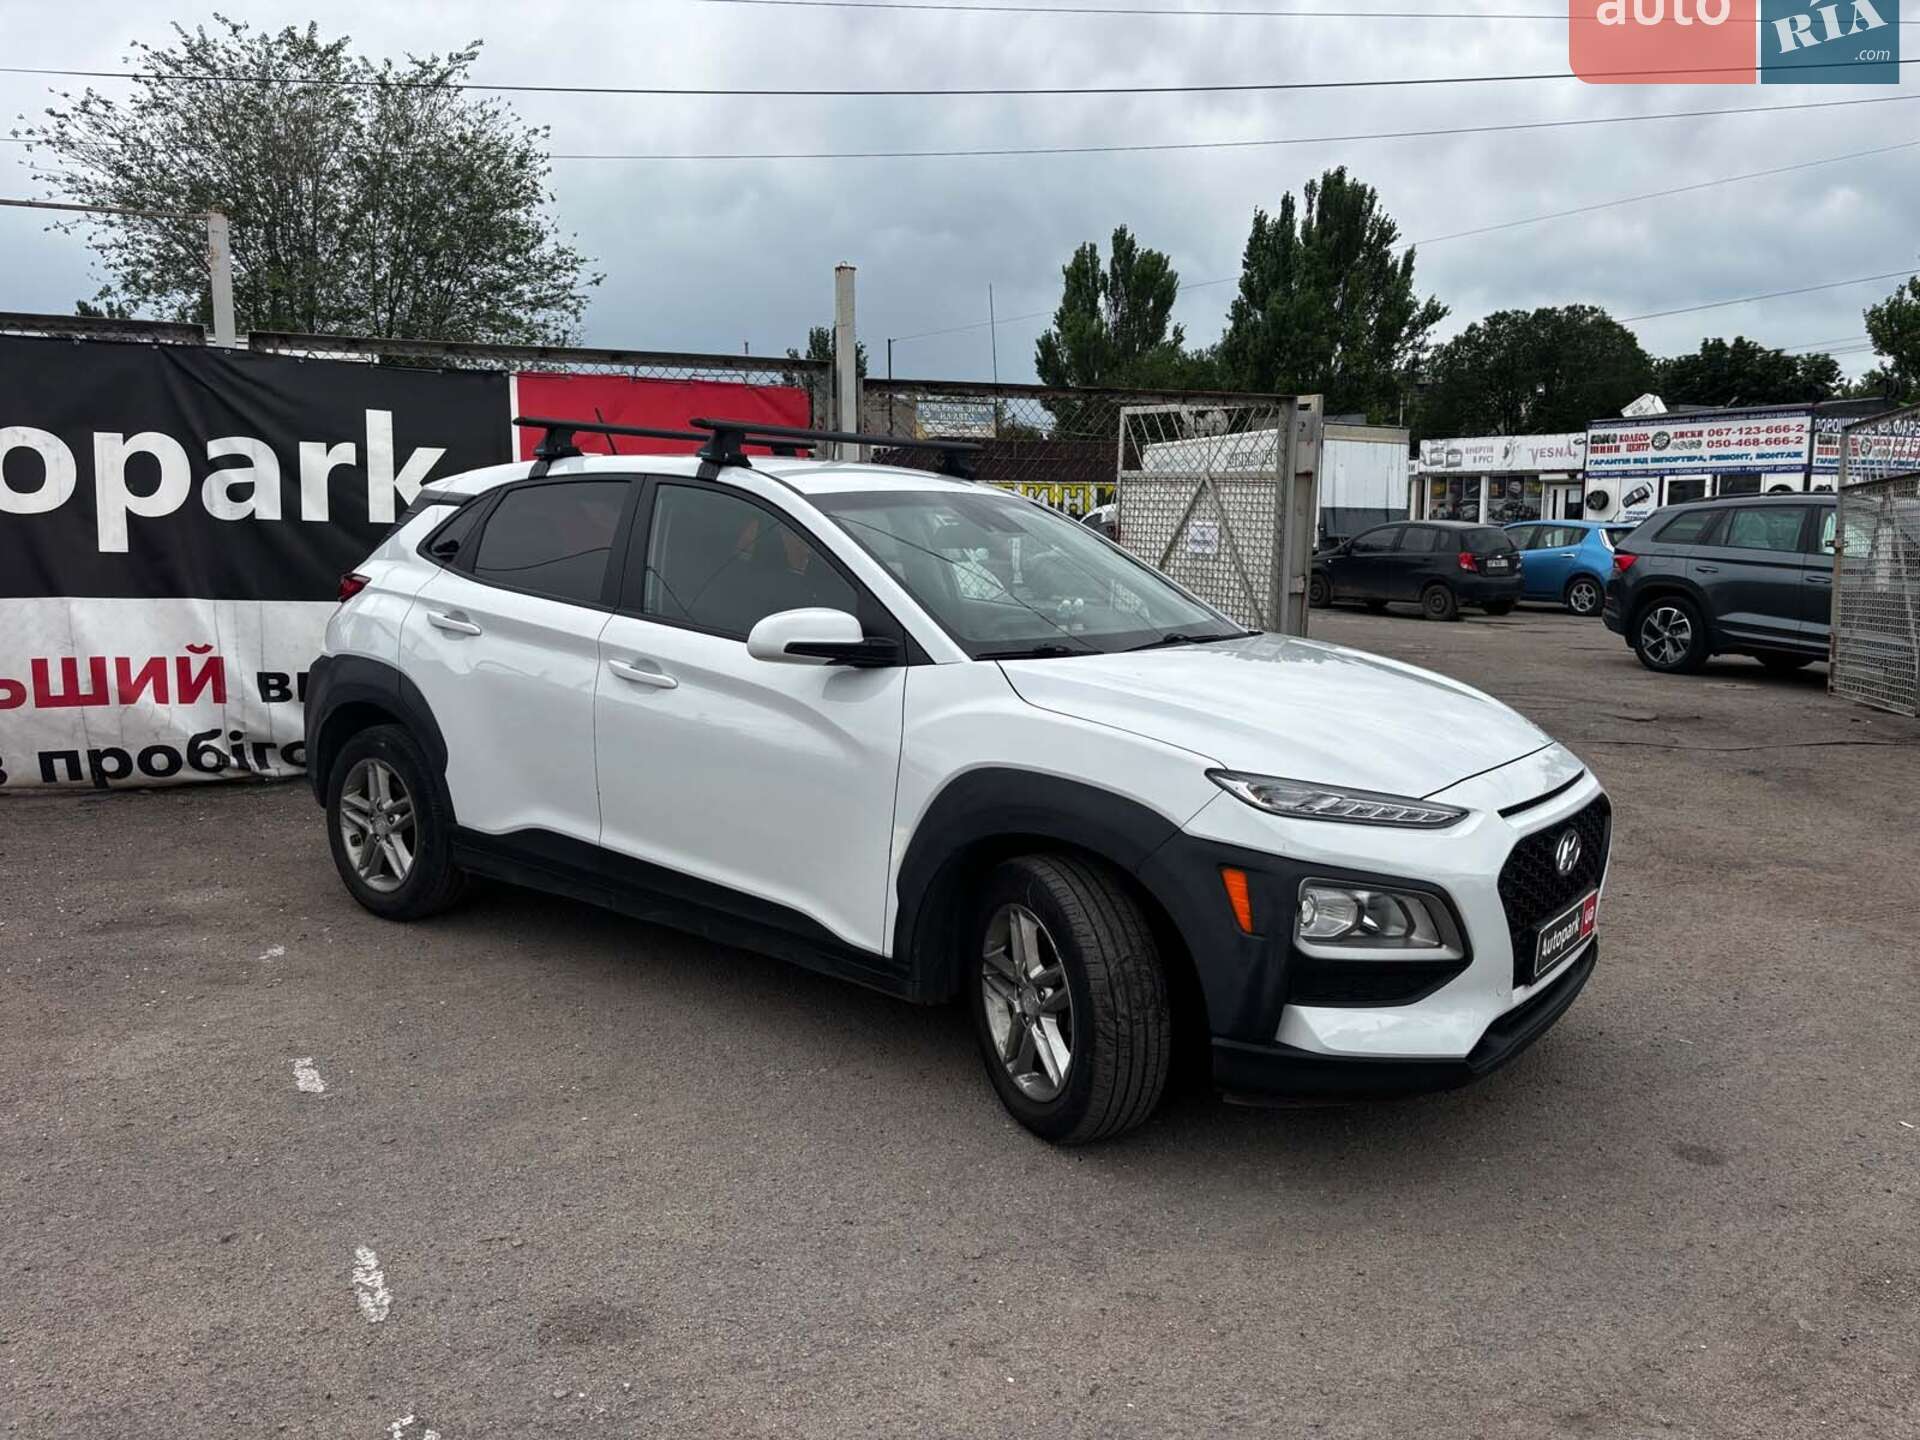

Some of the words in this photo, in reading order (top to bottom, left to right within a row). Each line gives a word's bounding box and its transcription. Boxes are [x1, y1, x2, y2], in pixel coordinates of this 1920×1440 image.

[1672, 430, 1704, 440] ДИСКИ
[1707, 424, 1805, 437] 067-123-666-2
[1706, 436, 1804, 449] 050-468-666-2
[1541, 911, 1581, 957] Autopark
